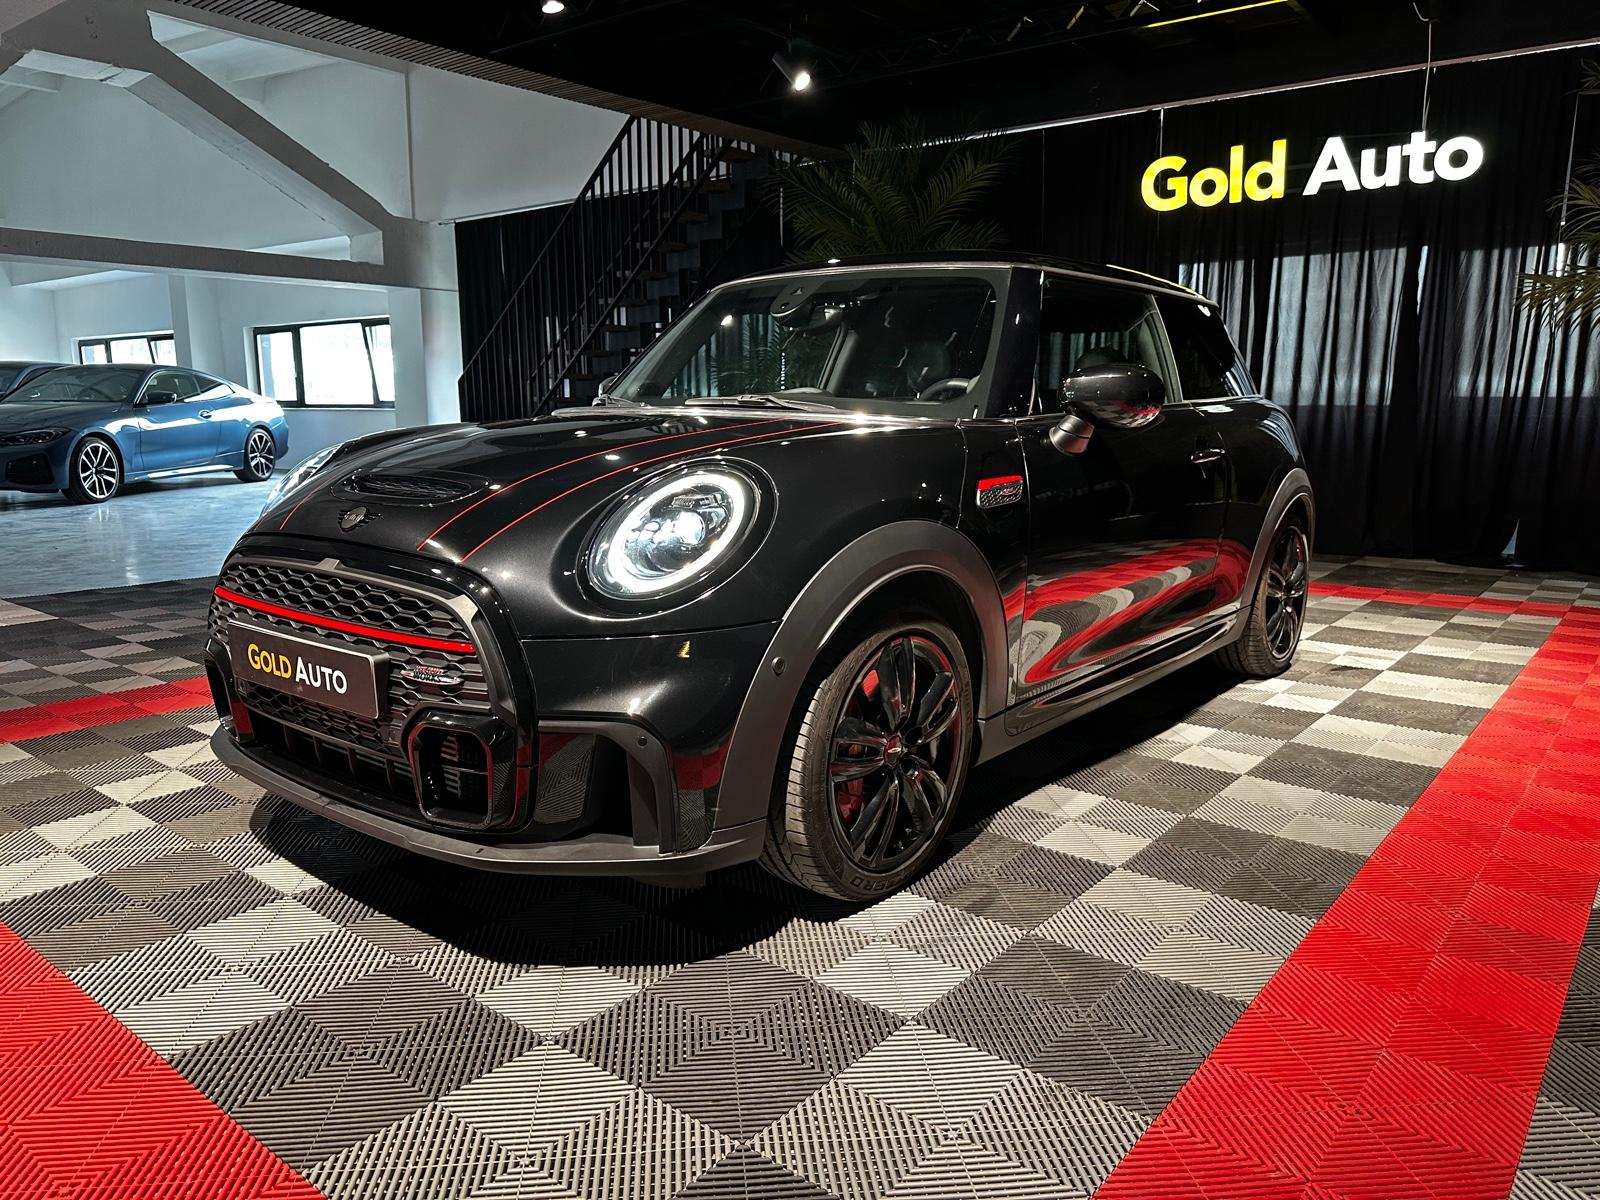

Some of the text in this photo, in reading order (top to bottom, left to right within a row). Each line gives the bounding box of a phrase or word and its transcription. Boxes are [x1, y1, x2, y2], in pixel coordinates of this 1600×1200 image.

[1141, 131, 1484, 211] Gold Auto
[247, 643, 348, 695] GOLD AUTO
